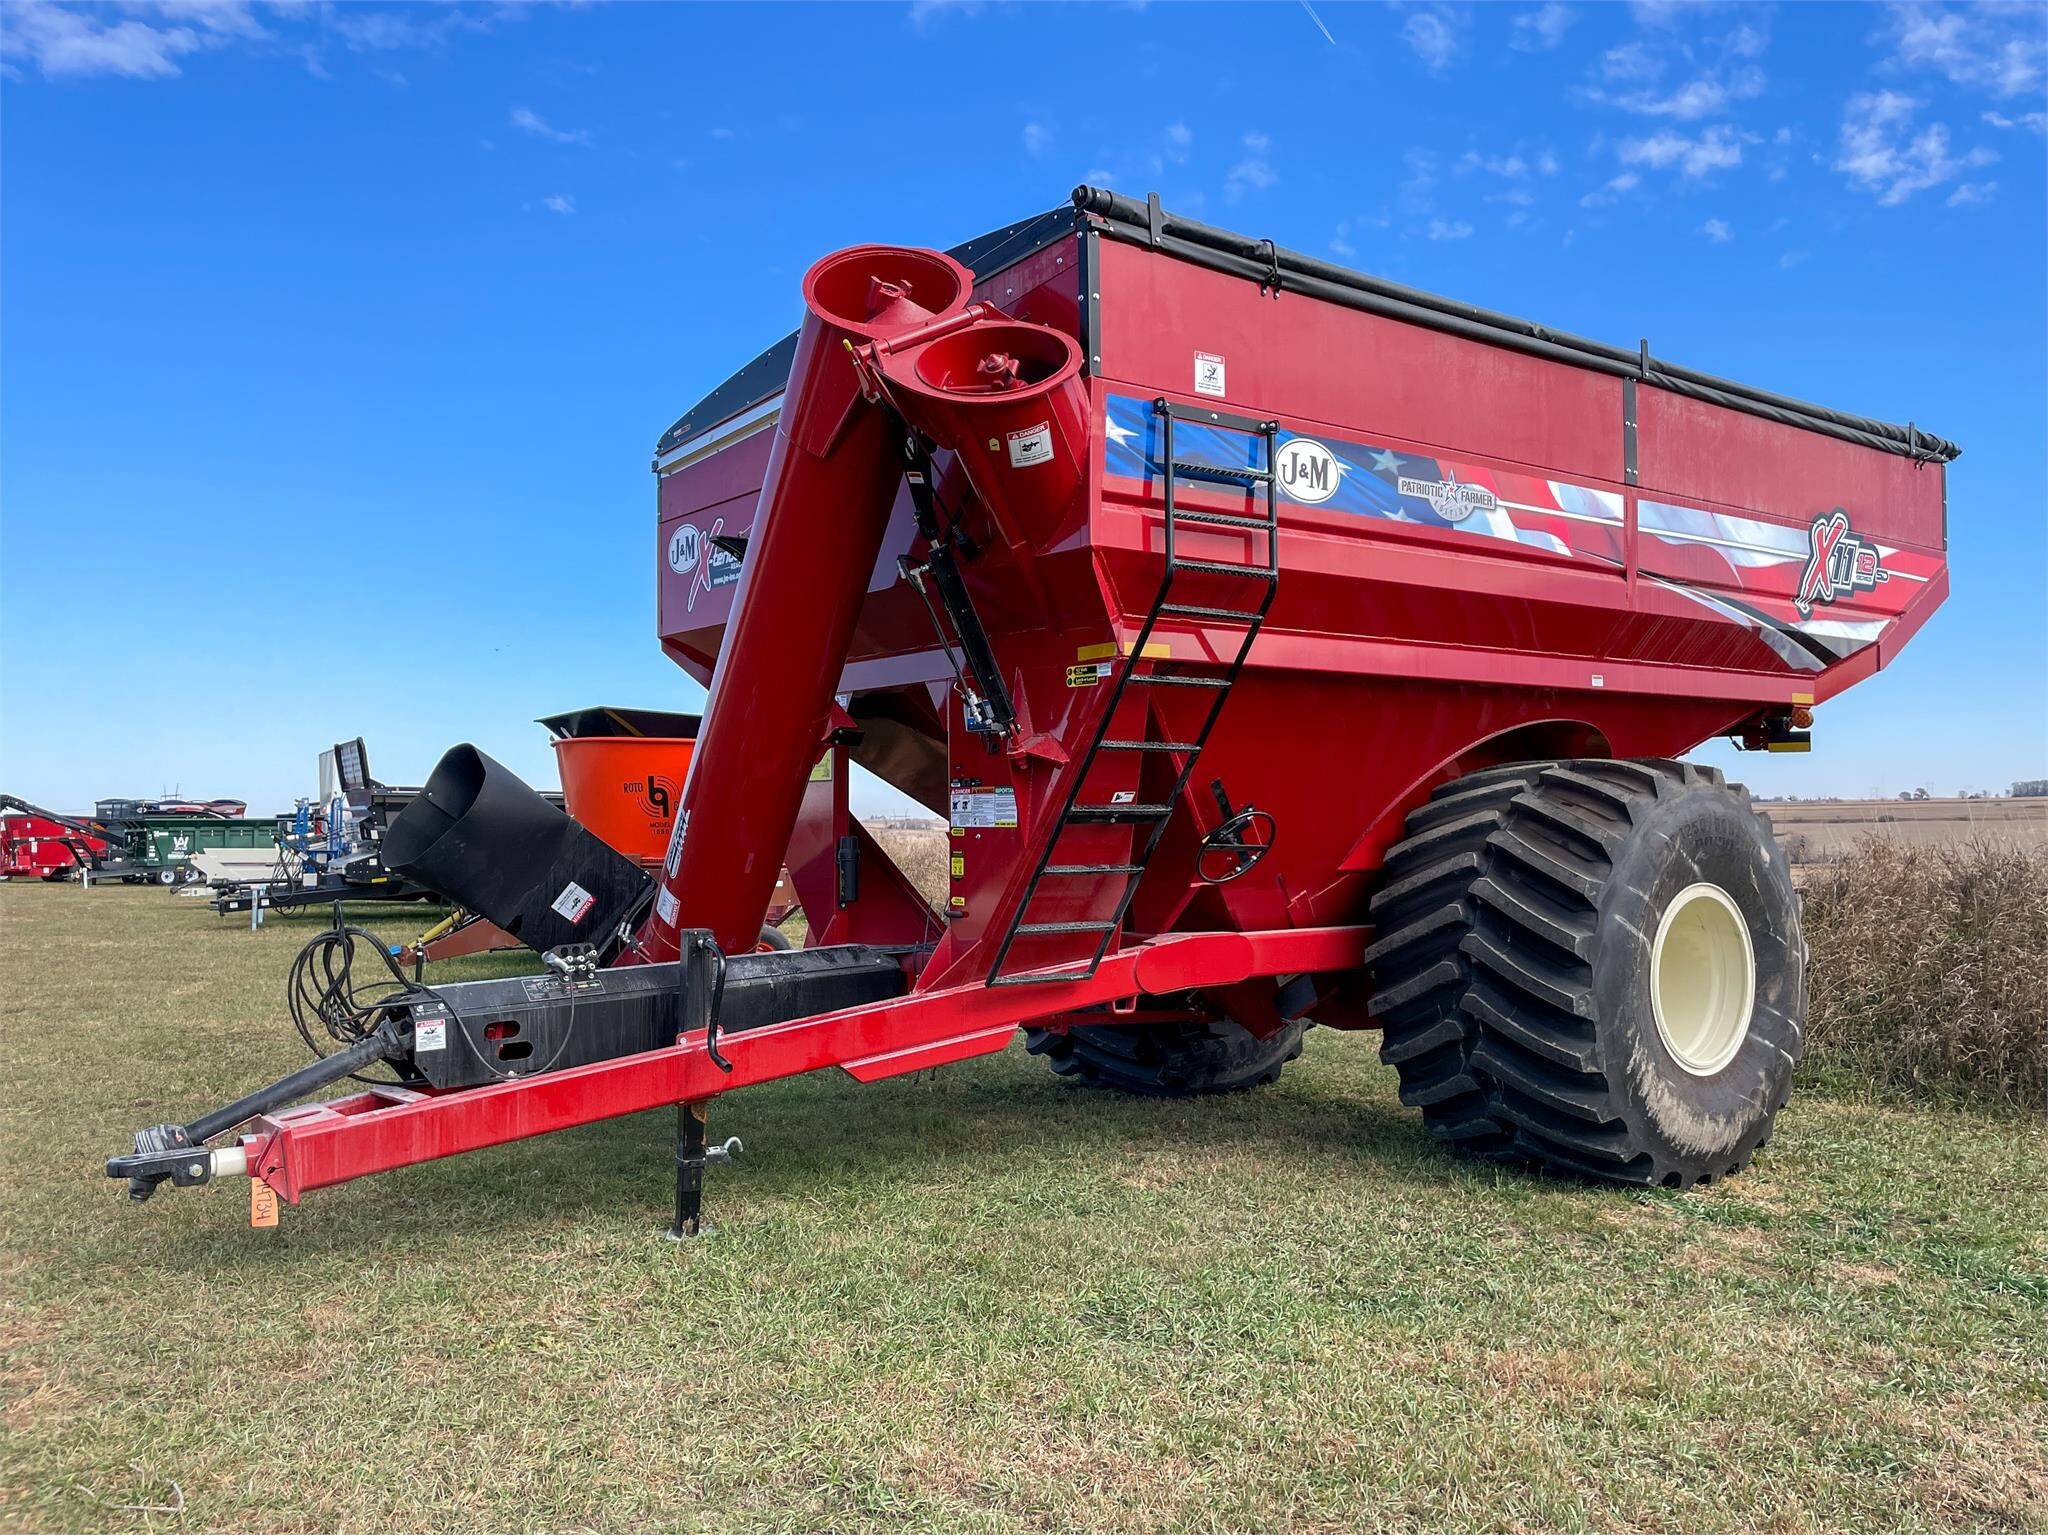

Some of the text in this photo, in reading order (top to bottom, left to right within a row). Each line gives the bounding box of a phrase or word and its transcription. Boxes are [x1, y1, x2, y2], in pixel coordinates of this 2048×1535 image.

[1019, 425, 1046, 438] DANGER
[1281, 451, 1330, 491] J&M
[1401, 480, 1493, 507] PATRIOTIC FARMER
[671, 533, 697, 565] J&M
[623, 782, 644, 793] ROTO
[649, 821, 673, 829] MODEL
[255, 1183, 273, 1220] 14734
